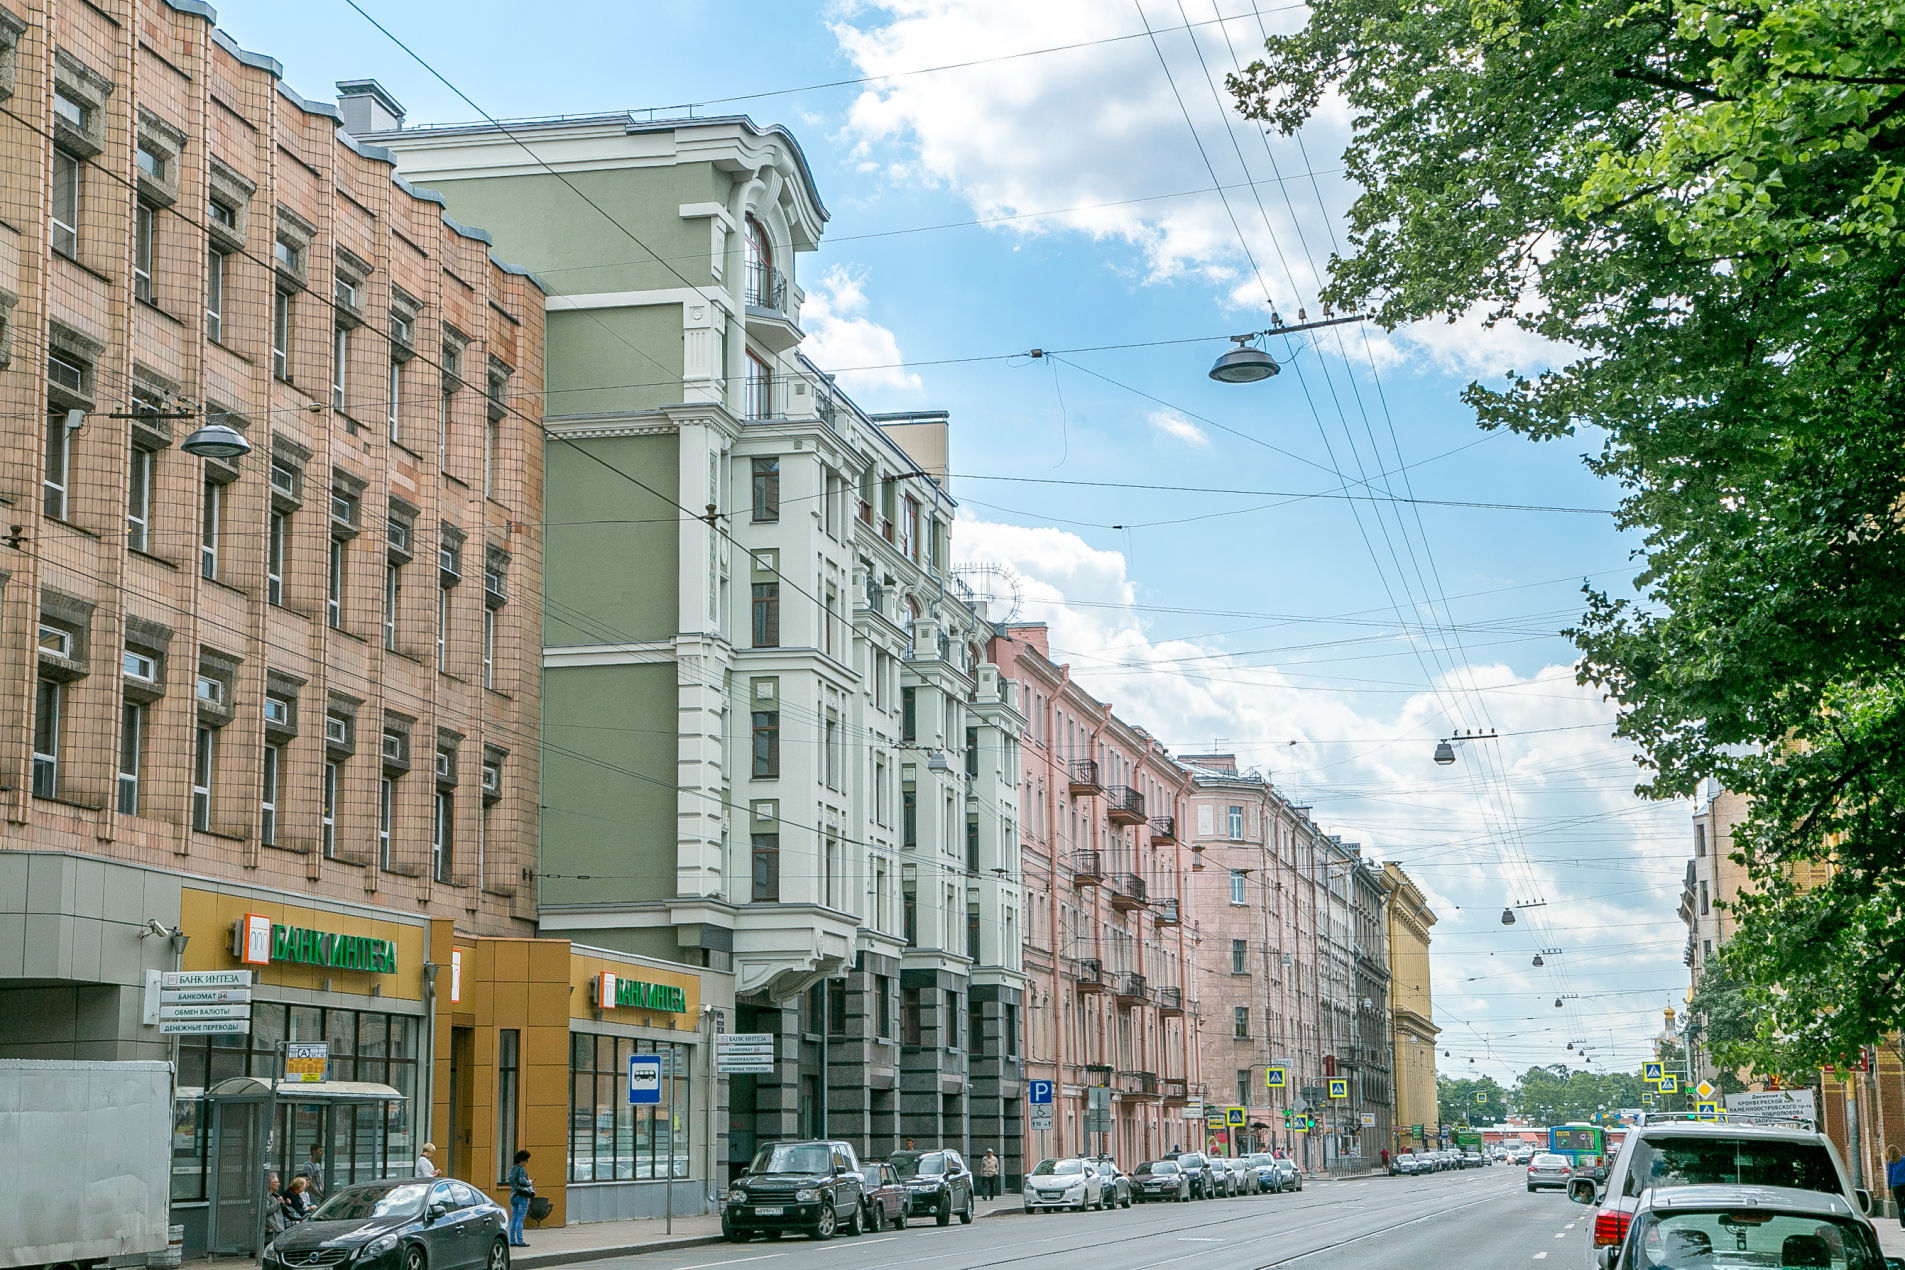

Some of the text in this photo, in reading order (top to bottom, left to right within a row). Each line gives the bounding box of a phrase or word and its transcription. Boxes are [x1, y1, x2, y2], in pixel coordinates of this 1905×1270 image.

[272, 924, 398, 974] БАНК ИНТЕЗА
[180, 974, 239, 984] БАНК ИНТЕЗА
[616, 978, 687, 1014] БАНК ИНТЕЗА
[1035, 1082, 1048, 1102] P
